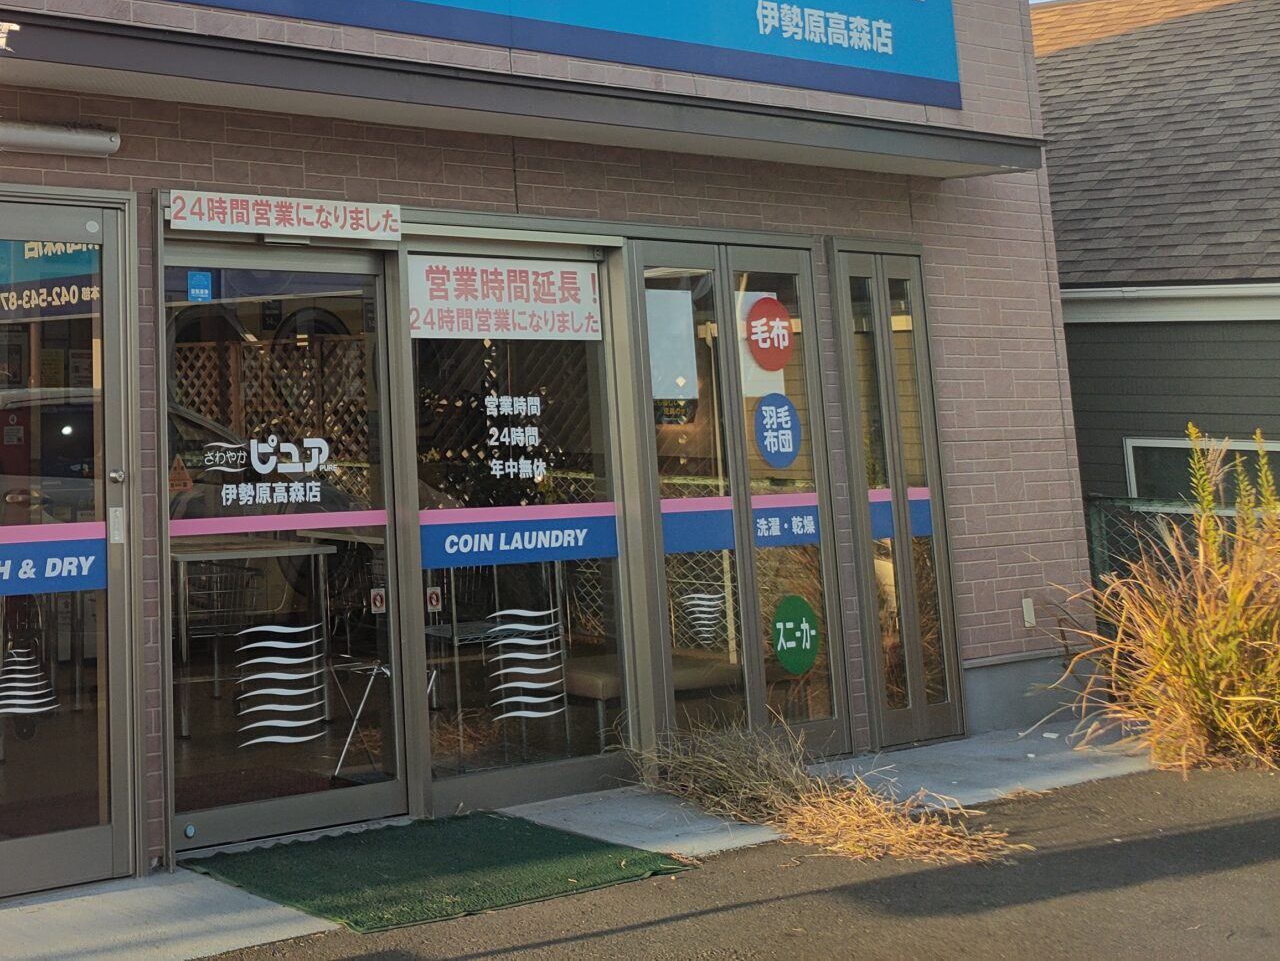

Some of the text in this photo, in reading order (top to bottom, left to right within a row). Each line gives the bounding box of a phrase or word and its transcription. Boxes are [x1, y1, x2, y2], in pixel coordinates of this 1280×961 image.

[756, 0, 893, 54] 伊勢原高森店
[171, 195, 400, 232] 24時間営業になりました
[425, 264, 598, 304] 営業時間延長！
[409, 307, 600, 333] 24時間営業になりました
[750, 317, 790, 350] 毛布
[484, 395, 541, 417] 営業時間
[761, 405, 791, 430] 羽毛
[488, 426, 539, 447] 24時間
[763, 429, 793, 453] 布団
[204, 434, 338, 474] さわやか ピュア PURE
[490, 457, 547, 479] 年中無休
[221, 481, 321, 506] 伊勢原高森店
[756, 515, 816, 537] 洗濯・乾燥
[445, 528, 588, 554] COIN LAUNDRY
[18, 559, 36, 579] &
[45, 556, 96, 578] DRY
[776, 617, 816, 651] スニーカー
